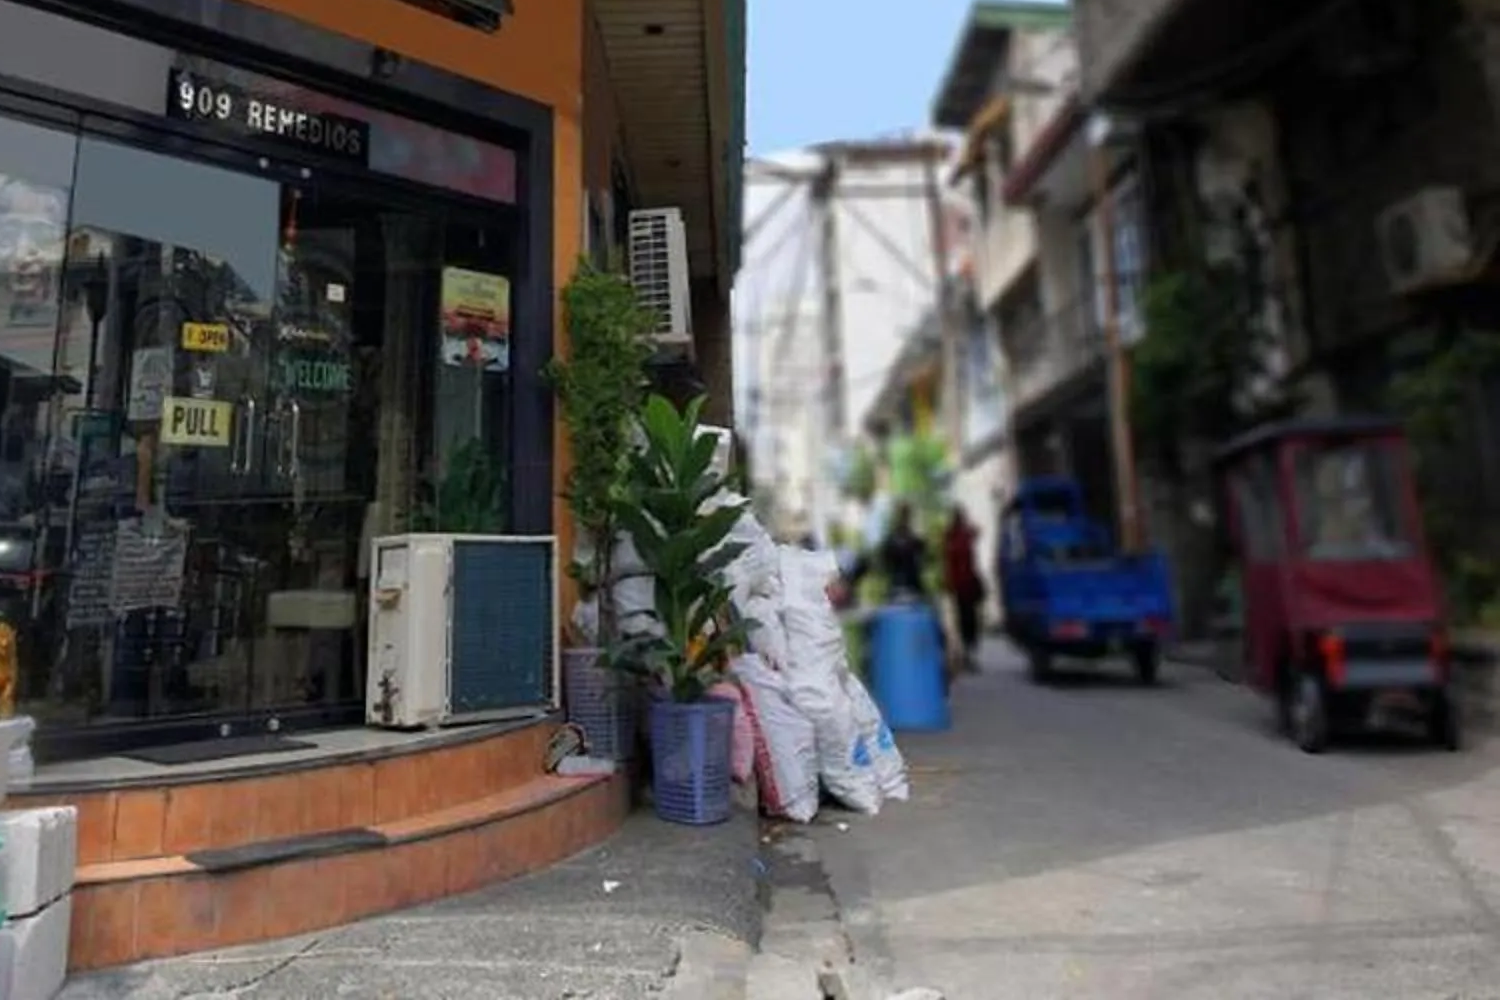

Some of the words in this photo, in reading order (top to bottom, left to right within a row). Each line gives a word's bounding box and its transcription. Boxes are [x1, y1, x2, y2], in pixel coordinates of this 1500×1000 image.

[179, 81, 232, 119] 909
[248, 100, 360, 154] REMEDIOS
[171, 405, 220, 438] PULL
